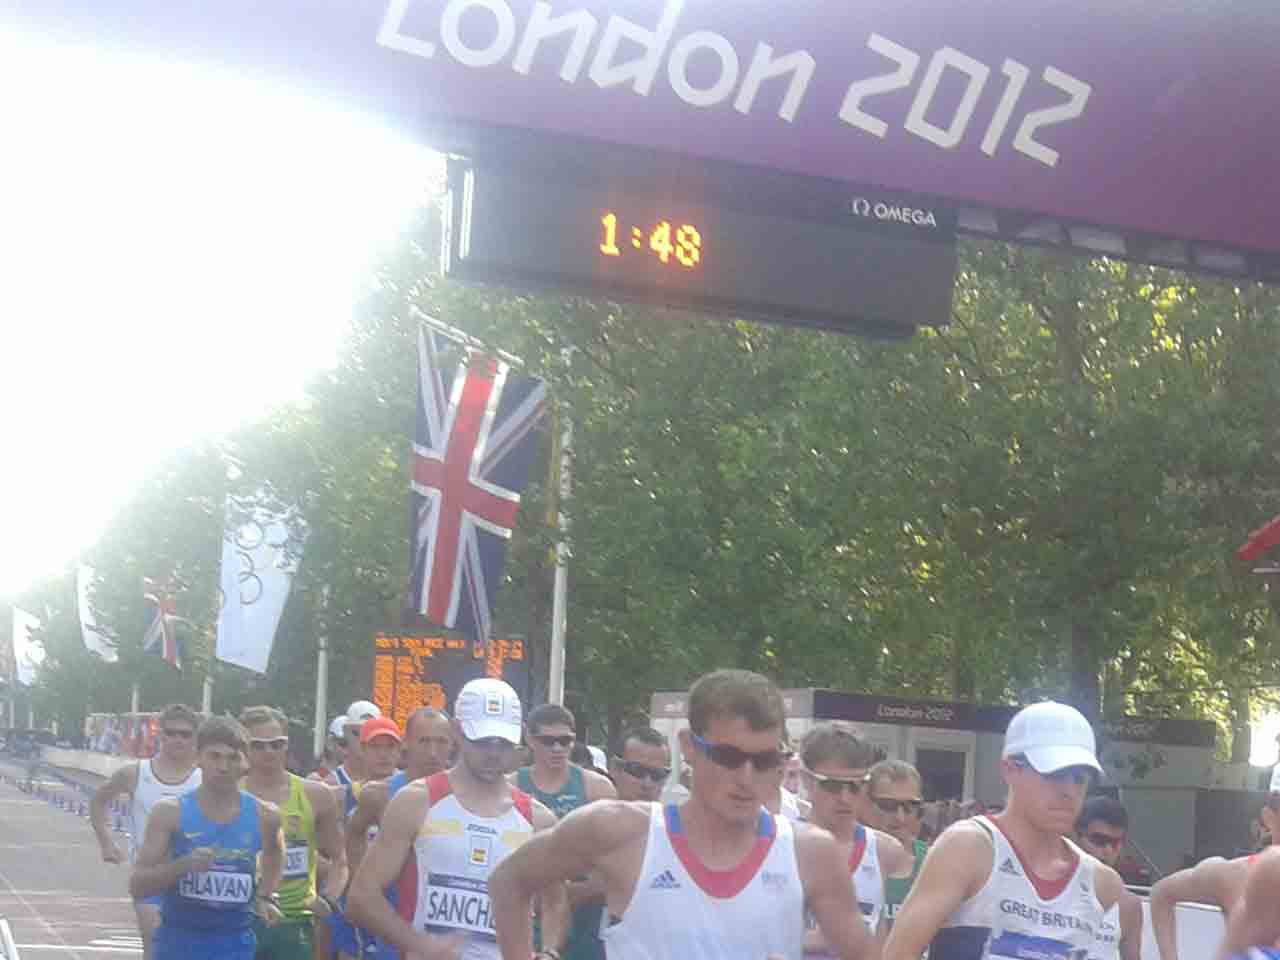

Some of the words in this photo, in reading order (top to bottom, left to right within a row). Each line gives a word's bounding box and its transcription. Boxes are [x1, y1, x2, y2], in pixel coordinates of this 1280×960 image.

[376, 0, 816, 123] London
[839, 33, 1092, 167] 2012
[873, 202, 937, 227] OMEGA
[601, 213, 701, 267] 1:48
[180, 872, 249, 898] HLAVAN
[427, 890, 497, 929] SANCH
[1000, 899, 1039, 922] GREAT
